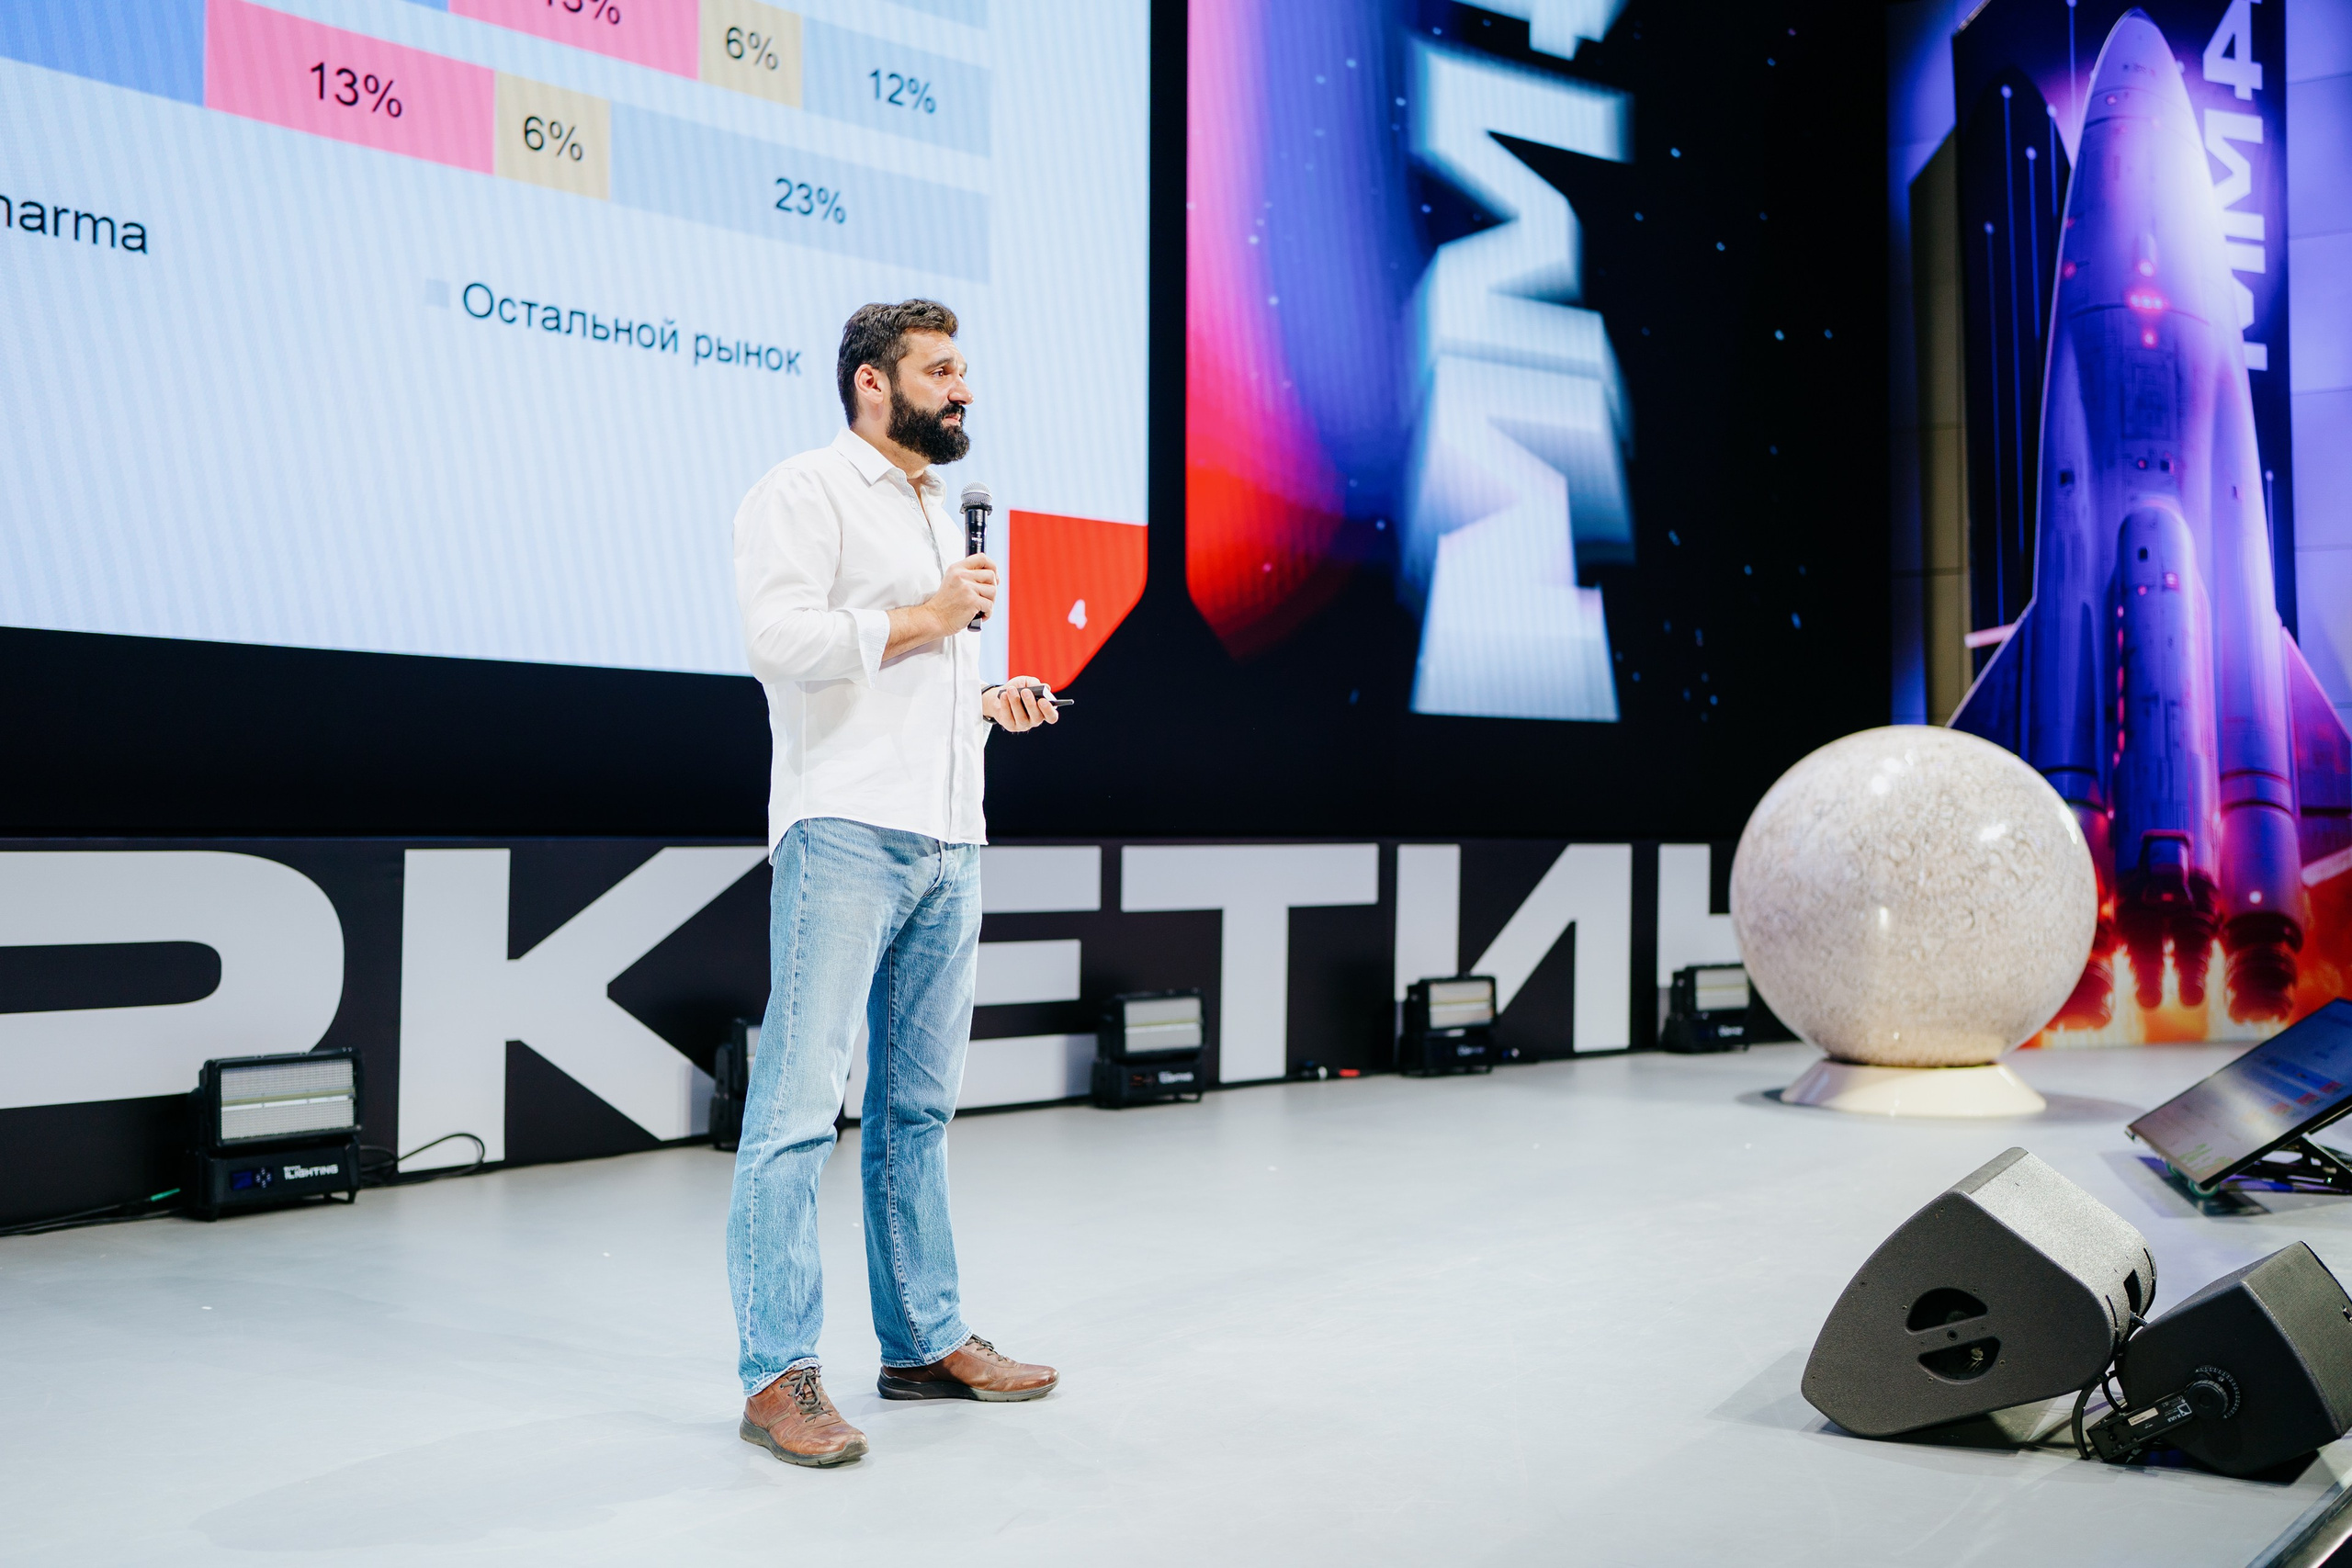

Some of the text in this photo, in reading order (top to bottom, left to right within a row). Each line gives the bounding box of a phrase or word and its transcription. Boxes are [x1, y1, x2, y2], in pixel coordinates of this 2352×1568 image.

[726, 27, 777, 70] 6%
[311, 62, 402, 118] 13%
[870, 69, 935, 114] 12%
[524, 116, 582, 161] 6%
[775, 177, 846, 224] 23%
[463, 283, 801, 374] Остальной рынок
[1068, 599, 1087, 629] 4
